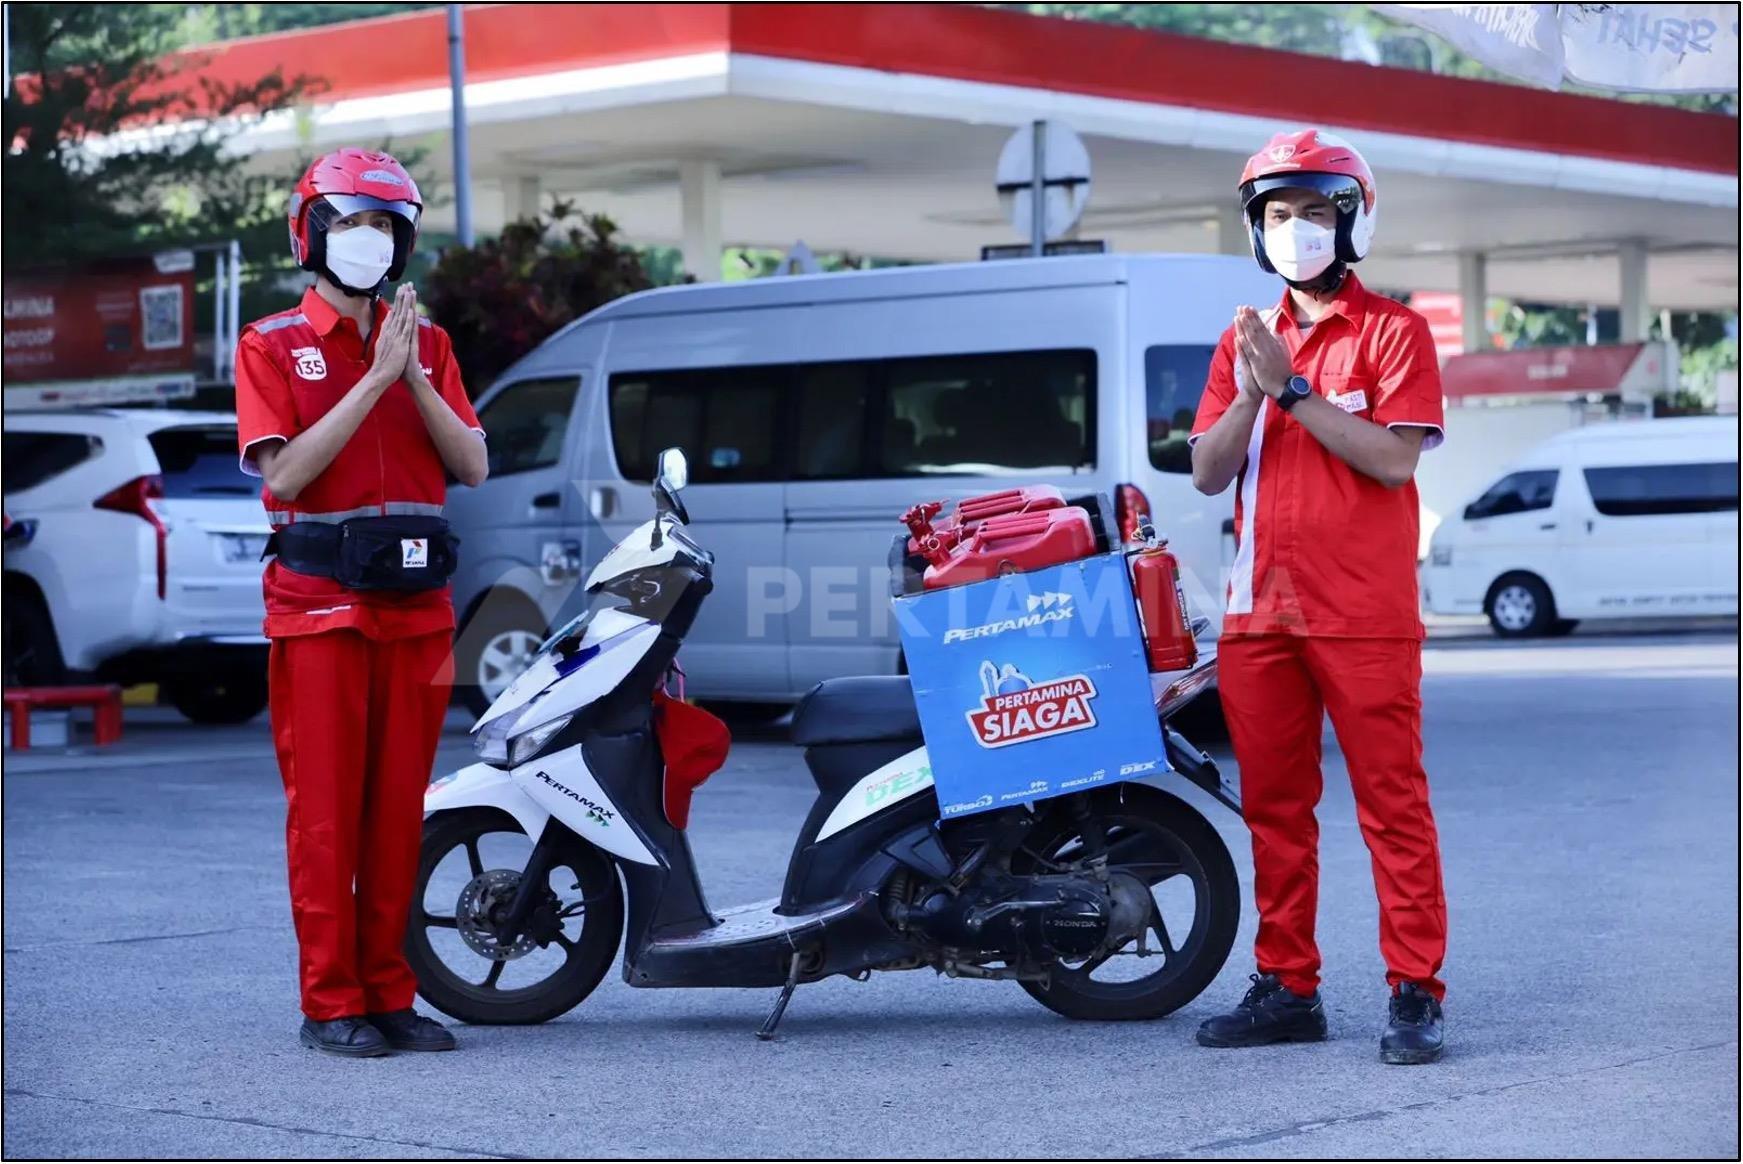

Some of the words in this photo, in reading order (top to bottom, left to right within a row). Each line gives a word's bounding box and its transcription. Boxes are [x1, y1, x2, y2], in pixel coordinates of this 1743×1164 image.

[297, 359, 325, 375] 135
[943, 606, 1074, 644] PERTAMAX
[995, 679, 1085, 711] PERTAMINA
[983, 696, 1085, 741] SIAGA
[535, 771, 615, 819] PERTAMAX
[866, 767, 935, 807] DEX
[1054, 919, 1097, 928] HONDA
